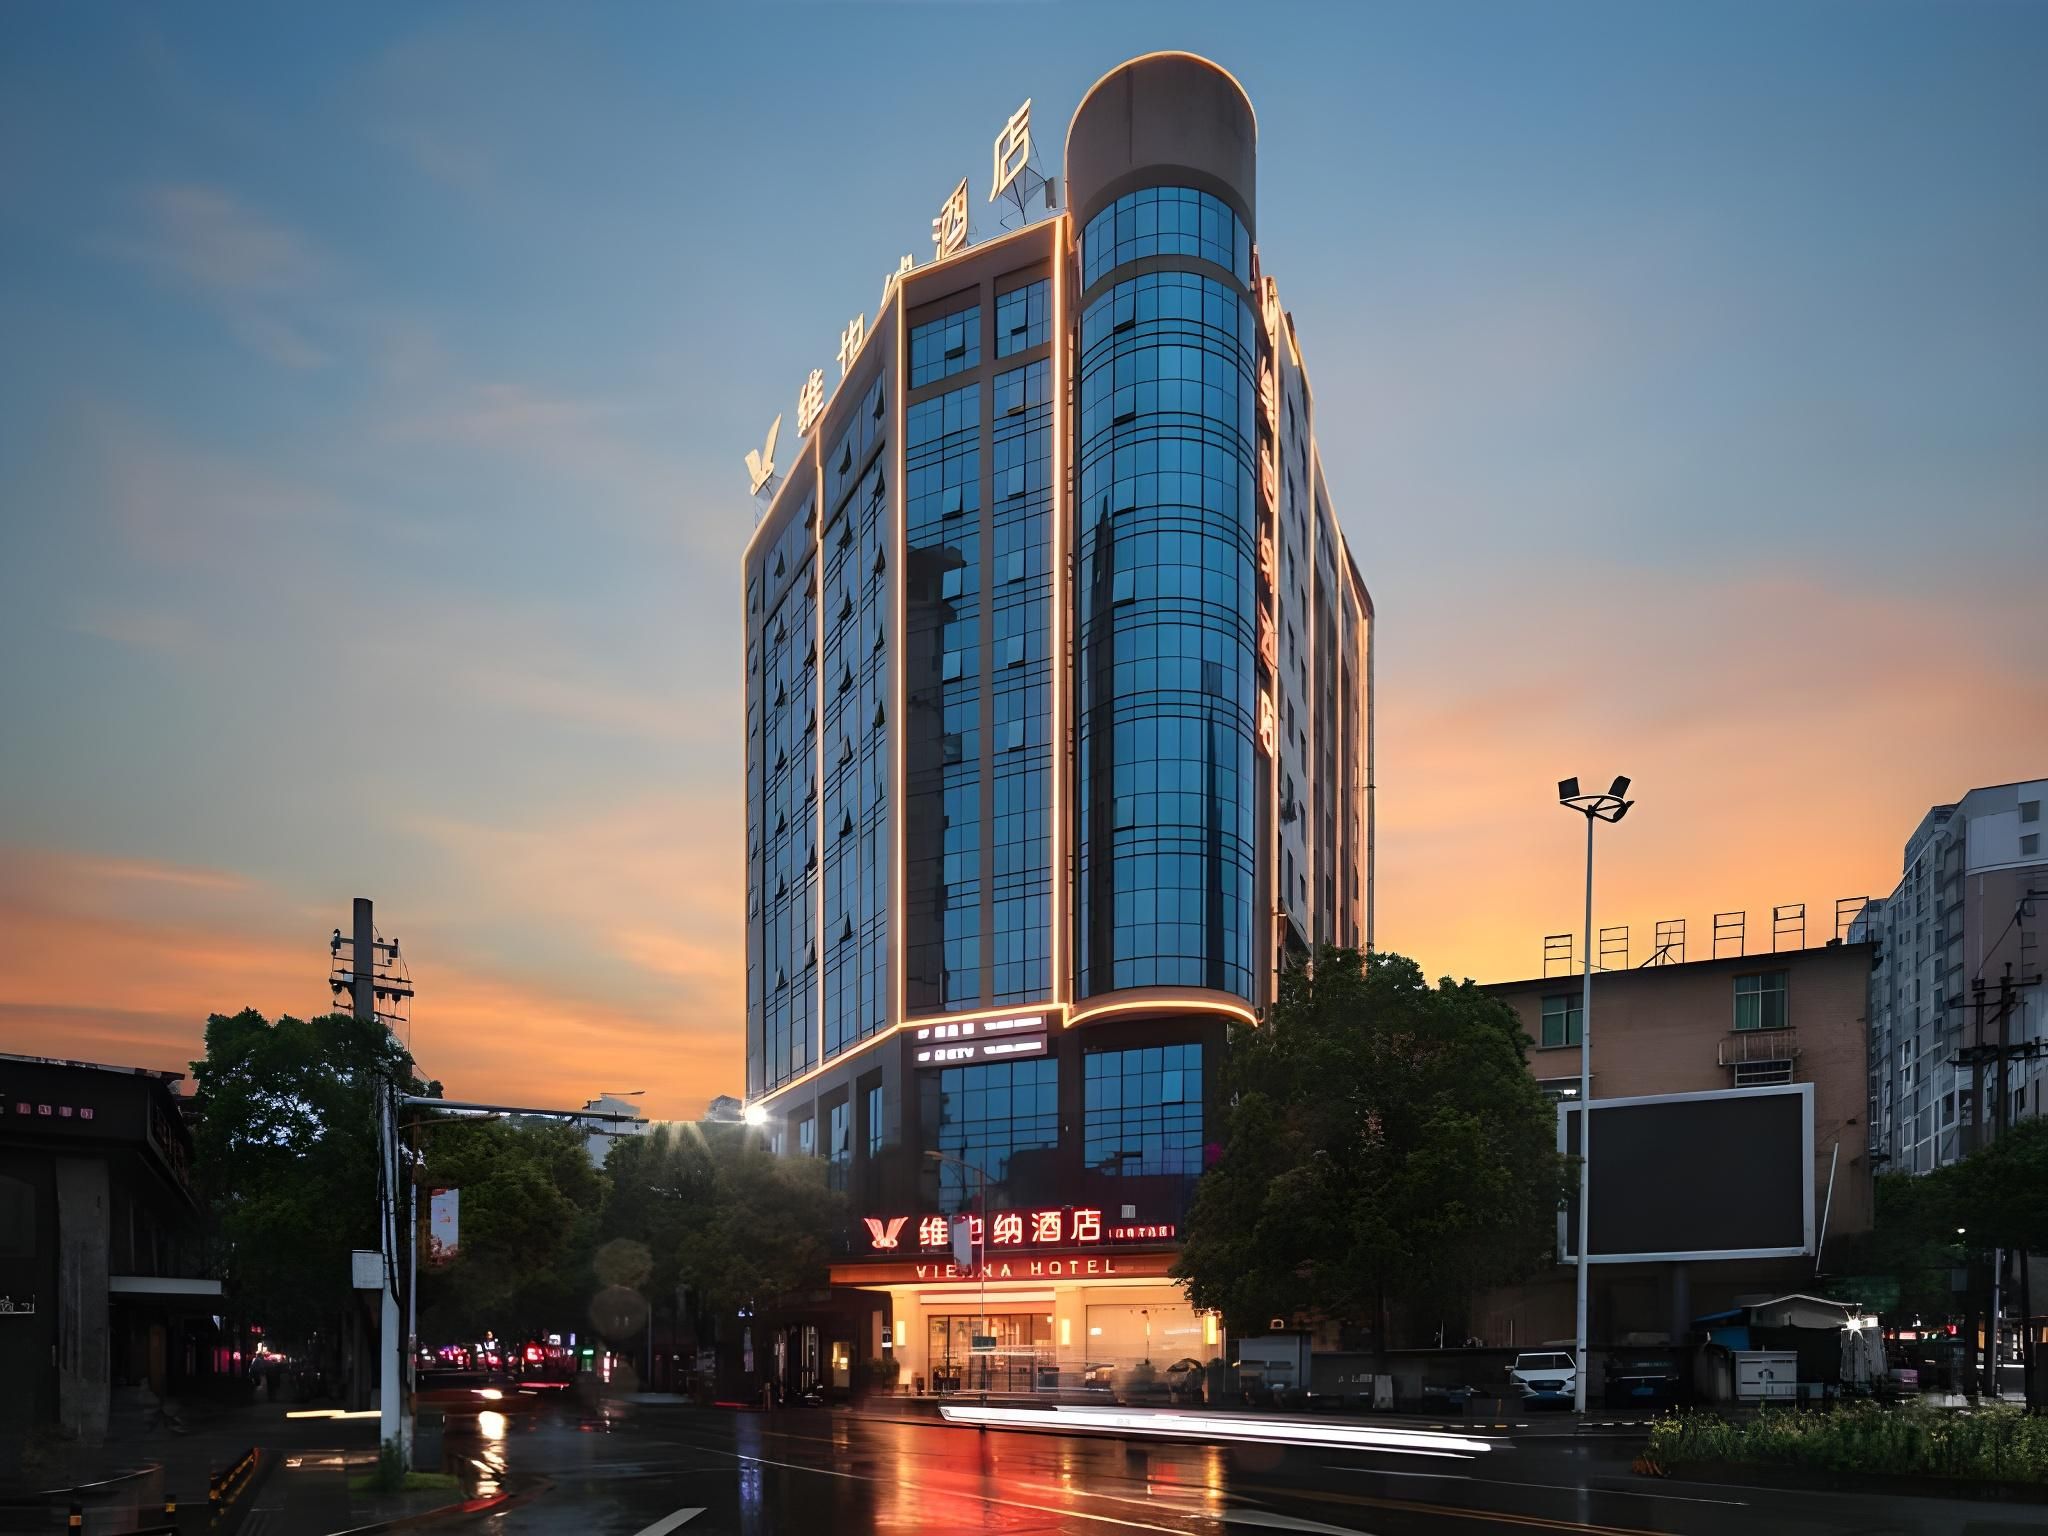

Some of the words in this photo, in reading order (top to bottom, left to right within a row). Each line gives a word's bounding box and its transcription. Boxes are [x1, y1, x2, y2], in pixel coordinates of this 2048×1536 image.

[797, 97, 1031, 438] 维也酒店
[916, 1263, 1012, 1278] VIENA
[1030, 1259, 1116, 1275] HOTEL
